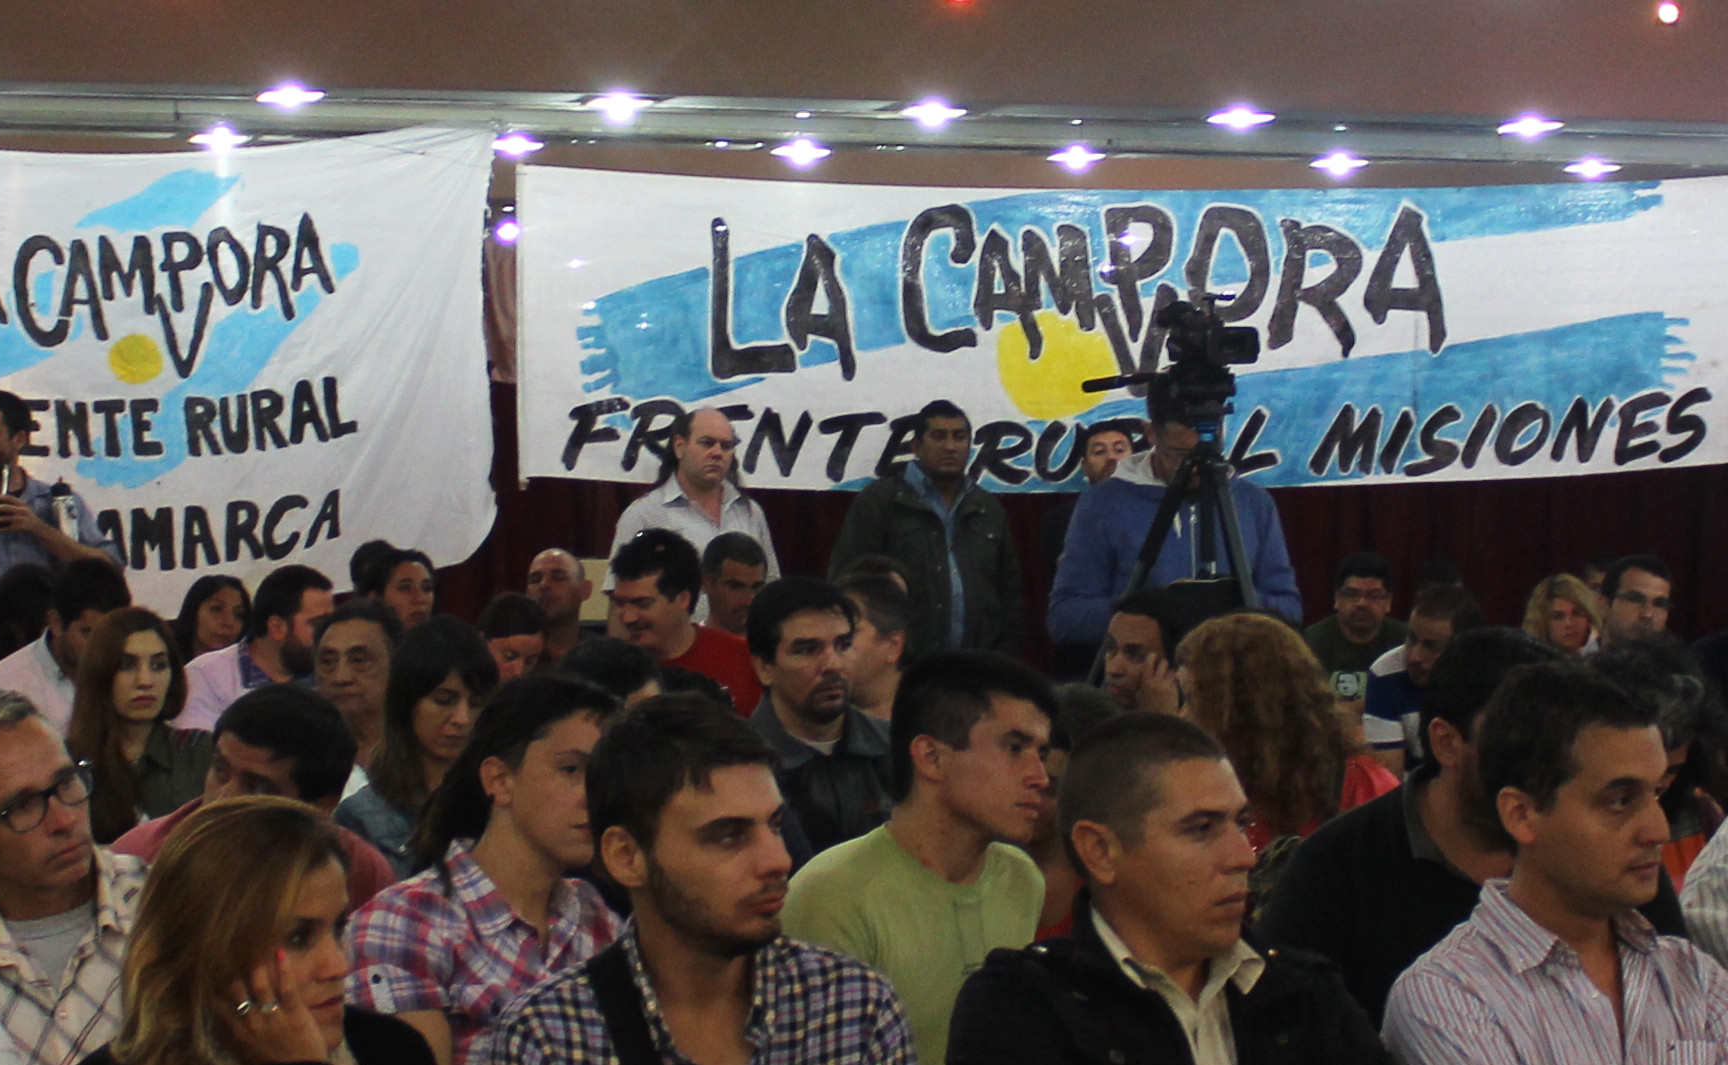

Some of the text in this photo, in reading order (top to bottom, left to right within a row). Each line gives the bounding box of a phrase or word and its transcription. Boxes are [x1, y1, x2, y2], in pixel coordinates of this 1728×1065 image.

[13, 212, 336, 350] CAMPORA
[711, 203, 1447, 380] LA CAMPORA
[184, 376, 357, 458] RURAL
[970, 406, 1280, 485] RUL
[1309, 388, 1712, 477] MISIONES
[97, 488, 341, 571] AMARCA
